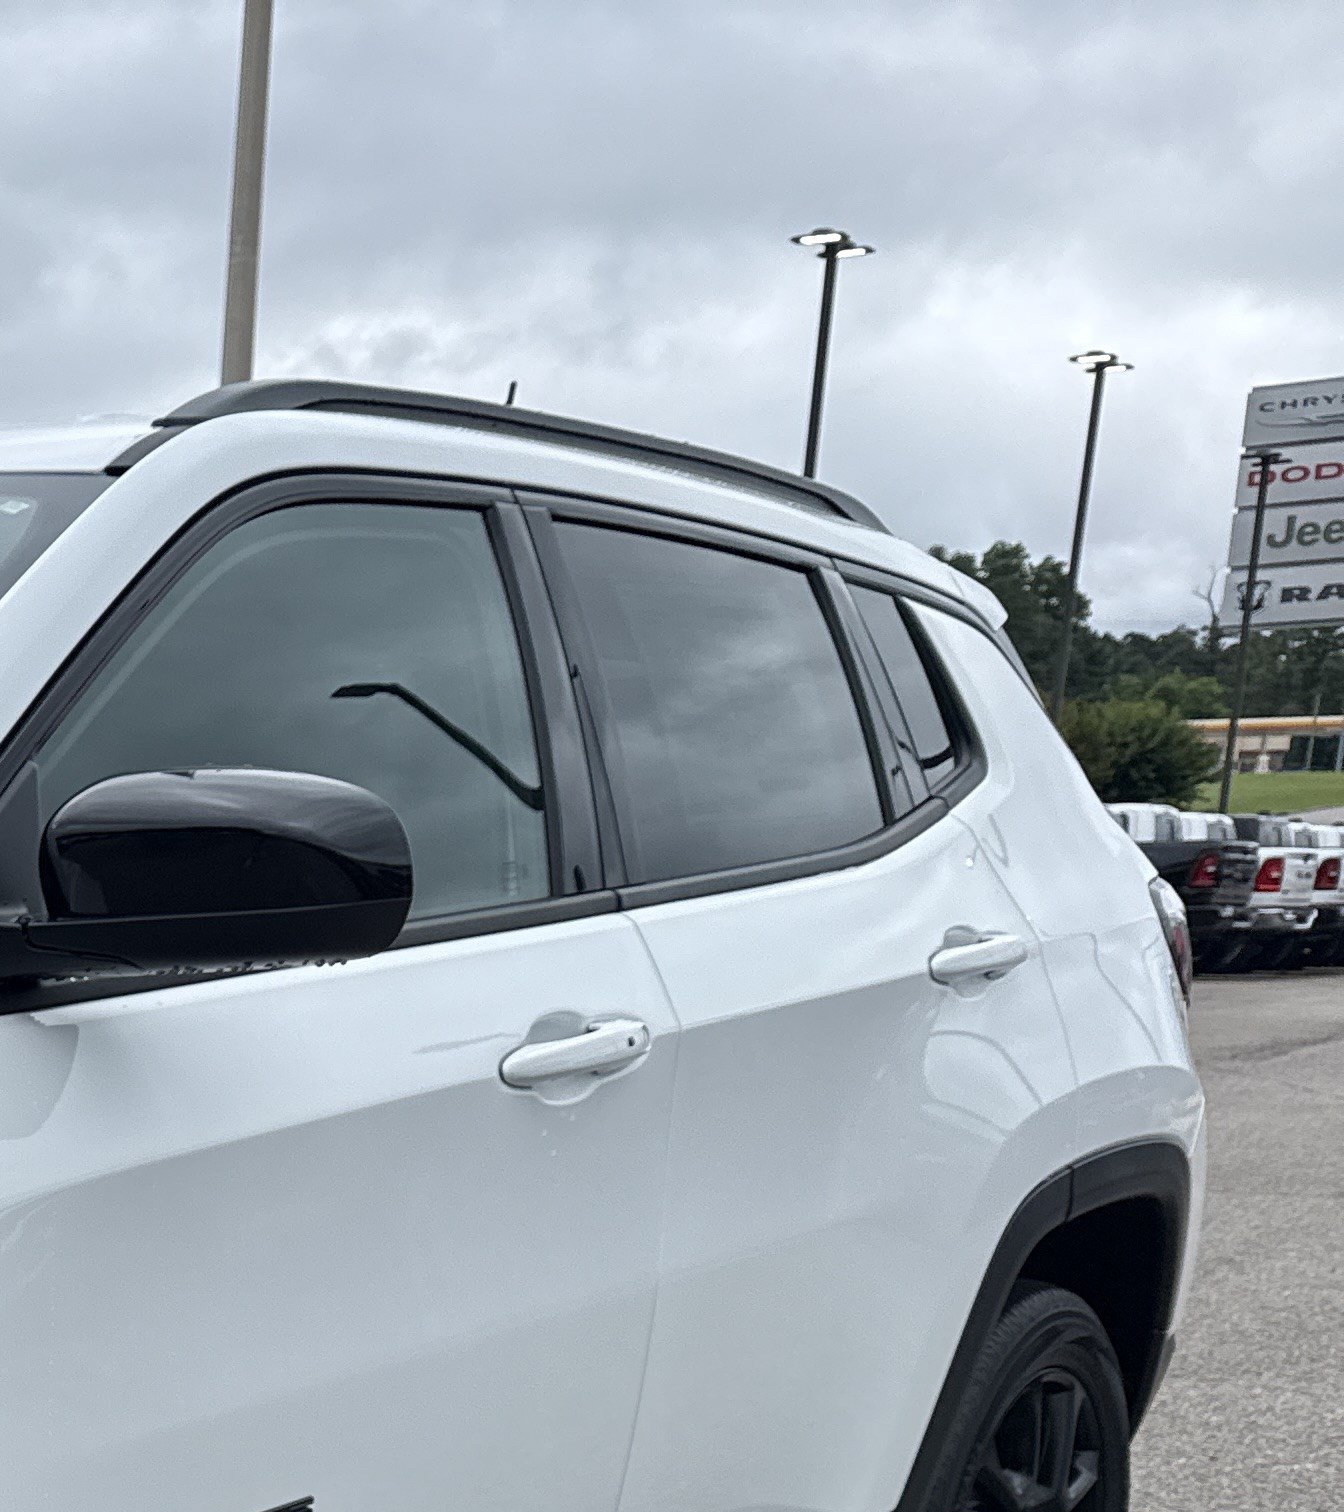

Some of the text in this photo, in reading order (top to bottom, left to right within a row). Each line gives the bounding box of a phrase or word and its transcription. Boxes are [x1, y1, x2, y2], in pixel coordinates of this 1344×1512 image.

[1259, 394, 1344, 413] CHRY
[1247, 462, 1344, 487] DOD
[1265, 514, 1344, 548] Jee
